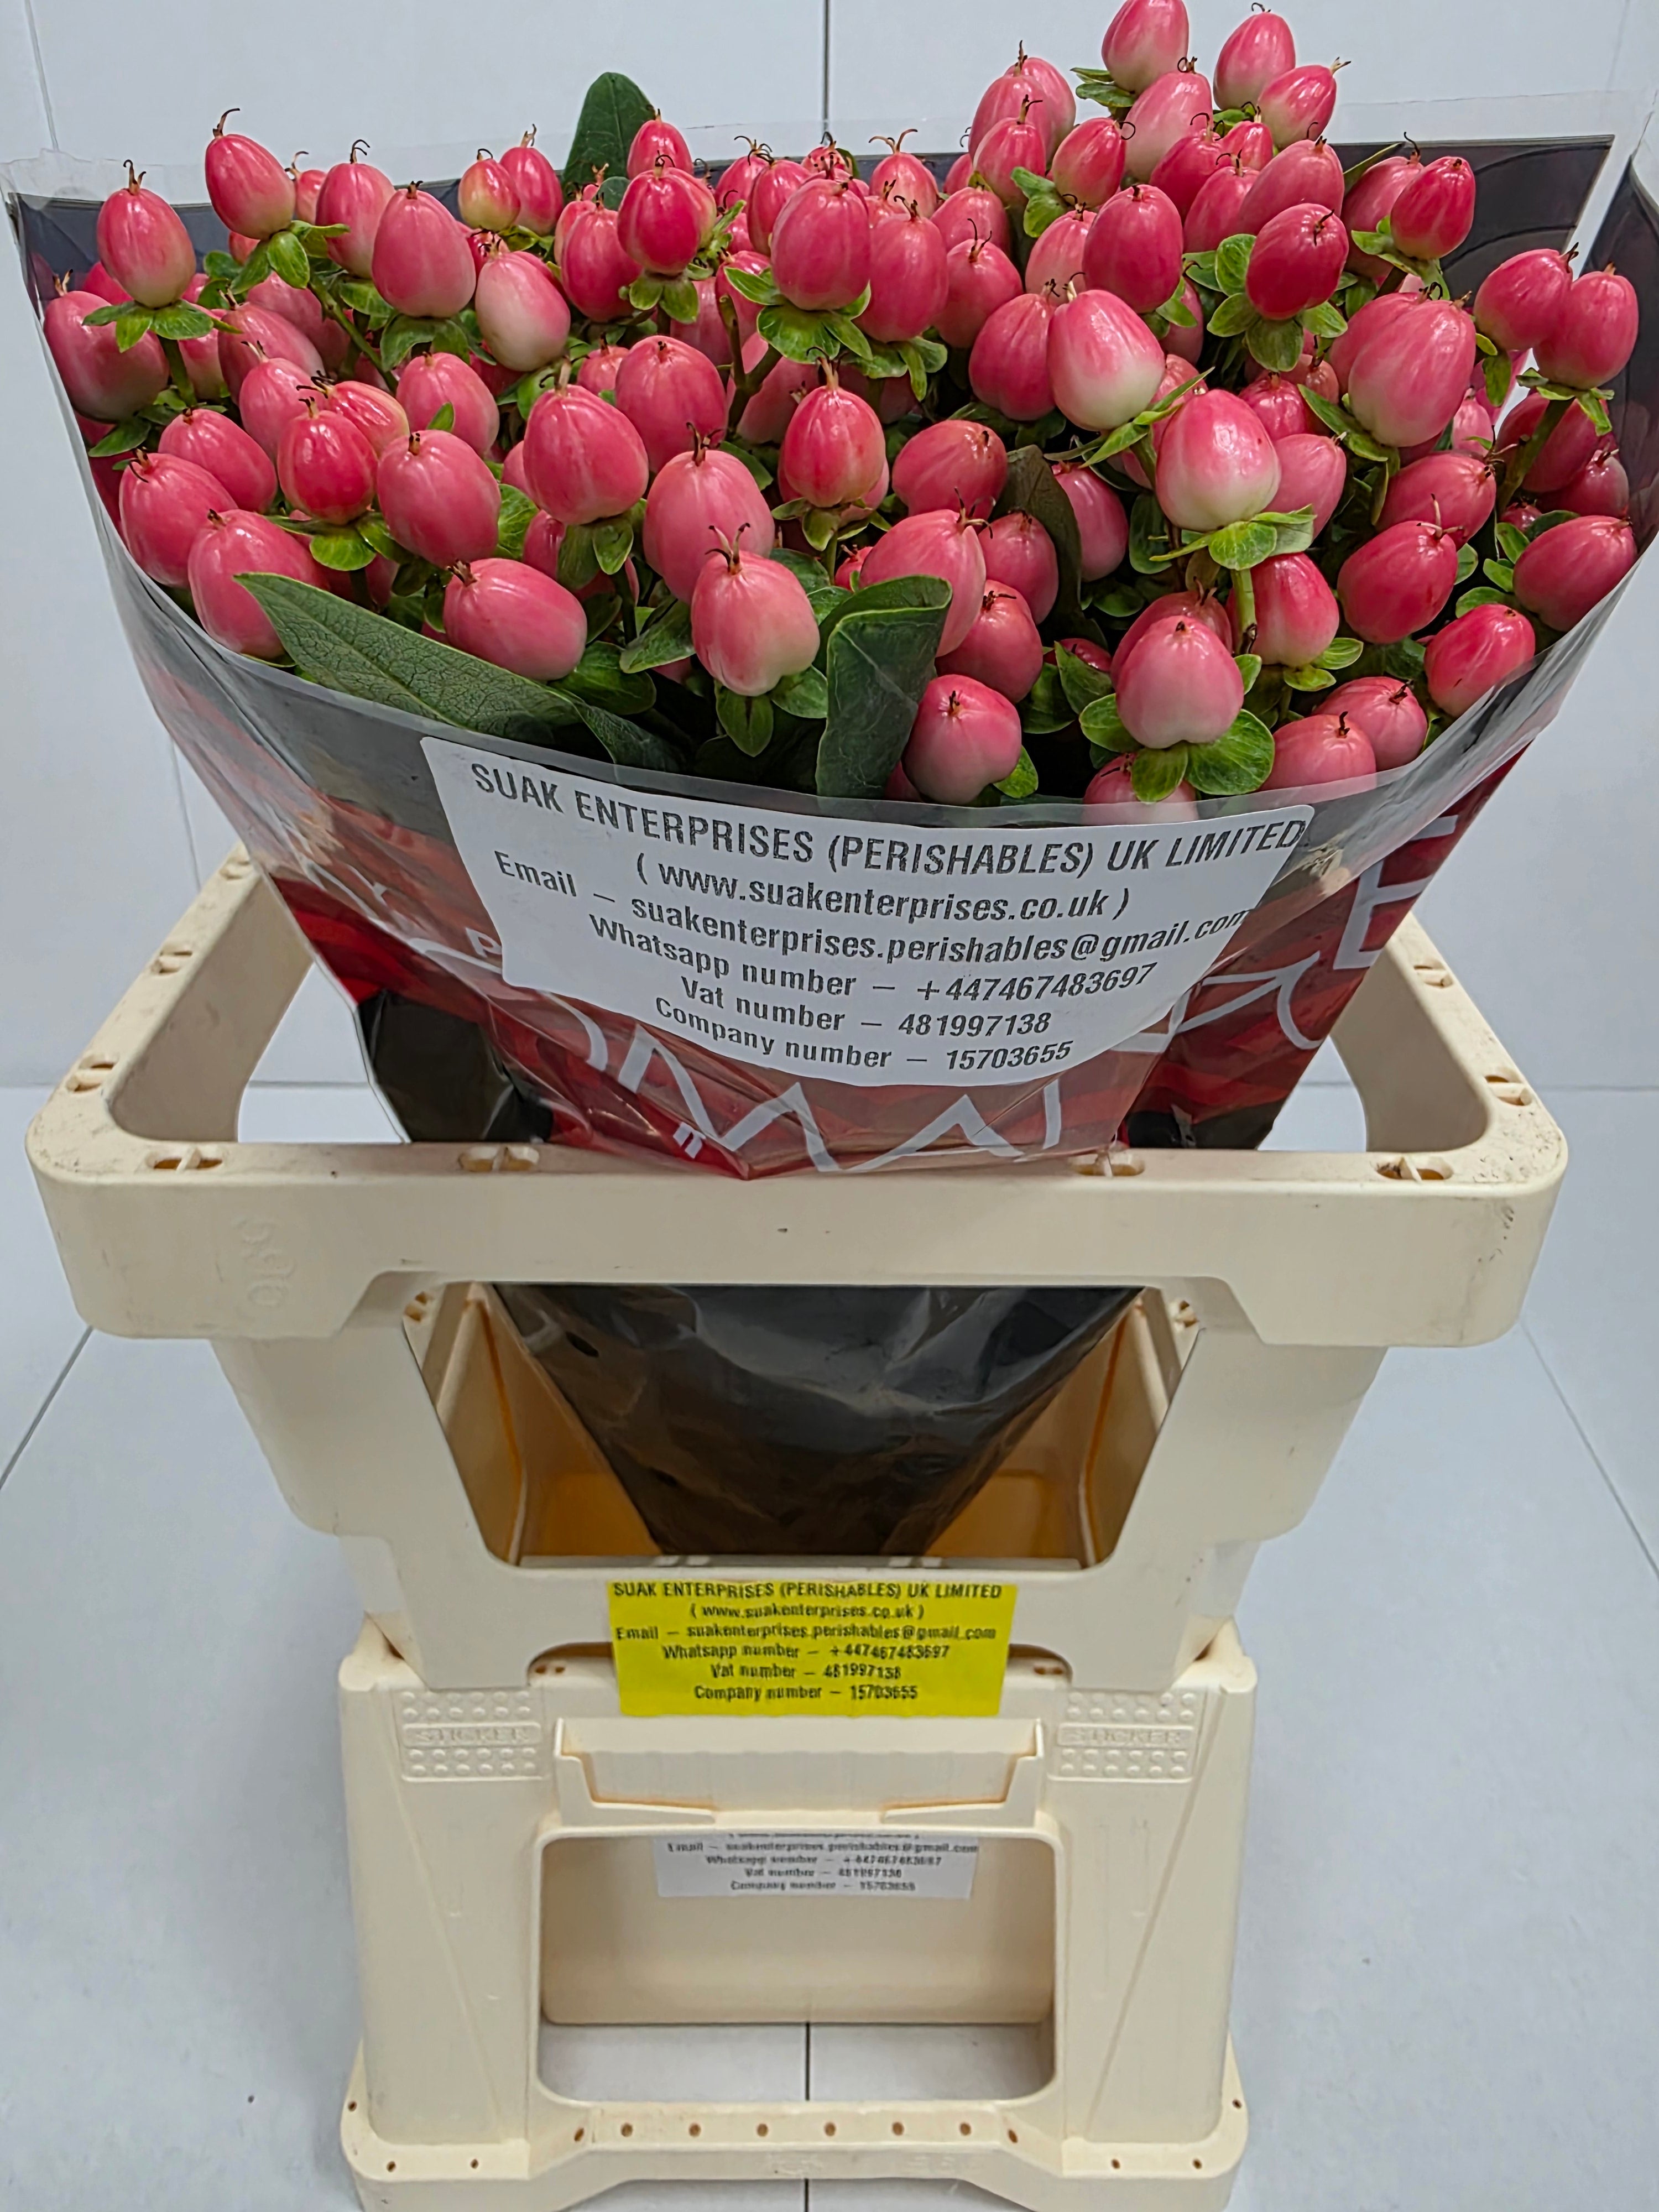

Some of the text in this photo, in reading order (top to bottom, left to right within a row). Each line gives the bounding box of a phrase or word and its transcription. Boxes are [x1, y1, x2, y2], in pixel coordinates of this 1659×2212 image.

[470, 762, 1306, 879] SUAK ENTERPRISES (PERISHABLES) UK LIMITED
[494, 850, 578, 898] Email
[659, 862, 1109, 924] www.suakenterprises.co.uk
[589, 913, 731, 979] Whatsapp
[741, 962, 857, 997] number
[681, 975, 725, 1009] Vat
[735, 996, 846, 1031] number
[898, 1011, 1052, 1037] 481997138
[656, 997, 776, 1056] Company
[785, 1040, 892, 1068] number
[946, 1040, 1074, 1071] 15703655
[613, 1582, 1003, 1599] SUAK ENTERPRISES (PERISHABLES) UK LIMITED
[701, 1603, 914, 1619] www.suakenterprises.co.uk
[615, 1626, 659, 1640] Email
[662, 1644, 738, 1660] Whatsapp
[741, 1643, 801, 1658] number
[709, 1663, 734, 1678] Vat
[739, 1663, 796, 1679] number
[693, 1684, 763, 1703] Company
[765, 1685, 822, 1700] number
